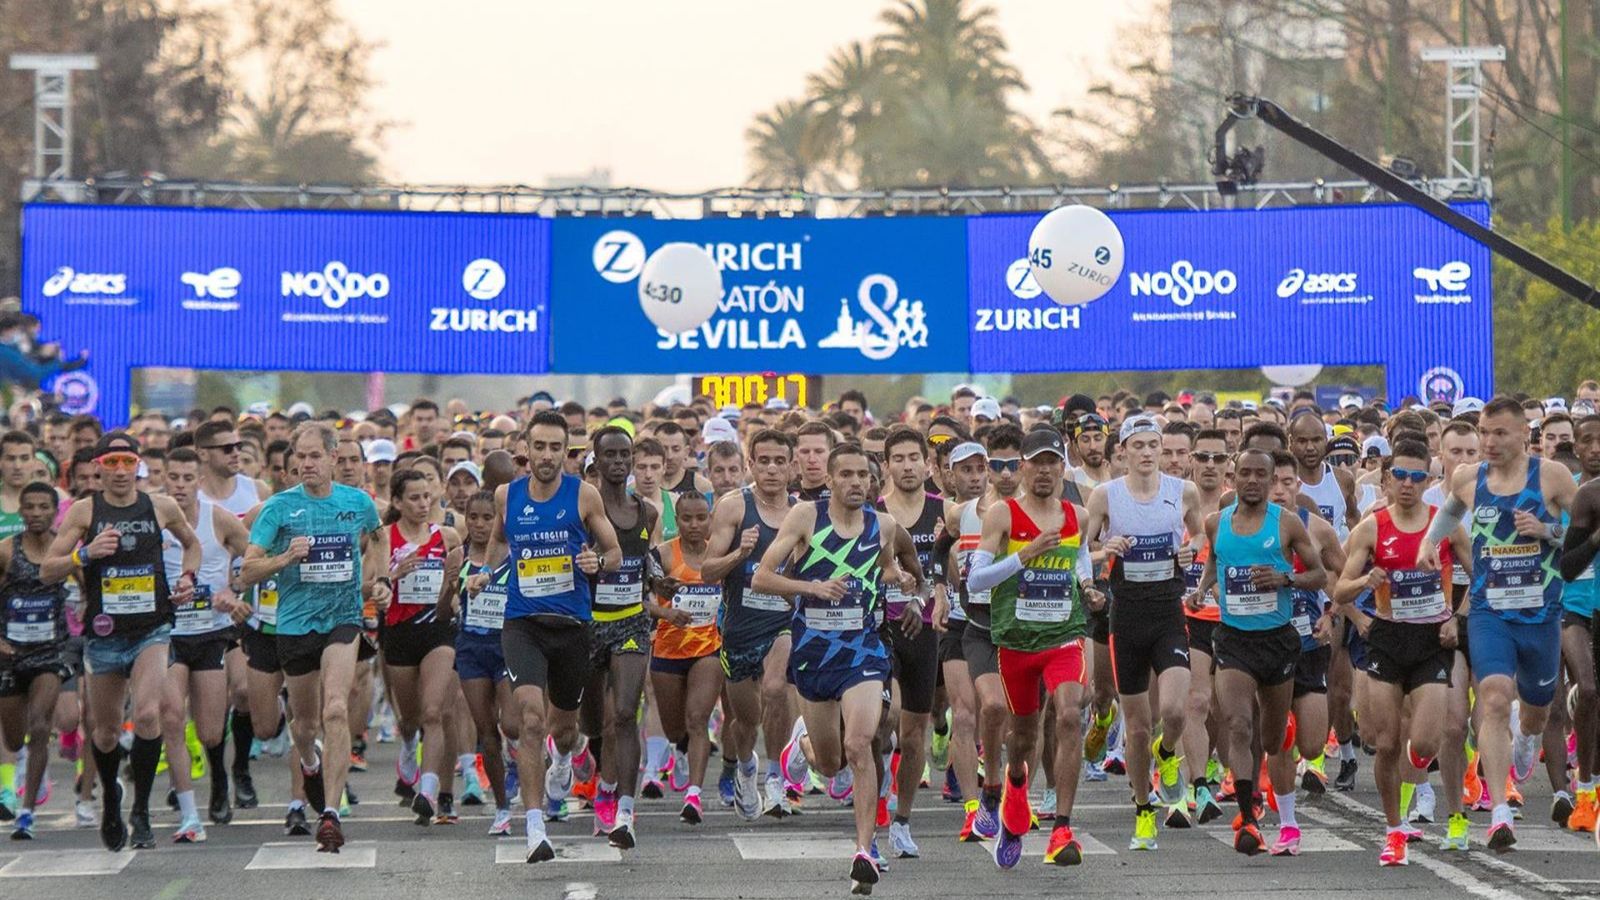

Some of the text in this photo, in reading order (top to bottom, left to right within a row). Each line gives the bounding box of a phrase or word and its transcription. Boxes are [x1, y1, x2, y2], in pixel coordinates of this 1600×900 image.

[706, 241, 803, 269] RICH
[1067, 262, 1111, 286] ZURIC
[429, 307, 538, 332] ZURICH
[974, 306, 1081, 332] ZURICH
[317, 536, 347, 544] ZURICH
[912, 533, 936, 544] RCO
[1139, 536, 1168, 545] ZURICH
[320, 551, 335, 560] 143
[533, 546, 565, 557] ZURICH
[1143, 552, 1156, 560] 171
[1503, 559, 1535, 568] ZURICH
[1036, 571, 1067, 580] ZURICH
[485, 585, 508, 593] ZURIC
[689, 585, 716, 594] ZURICH
